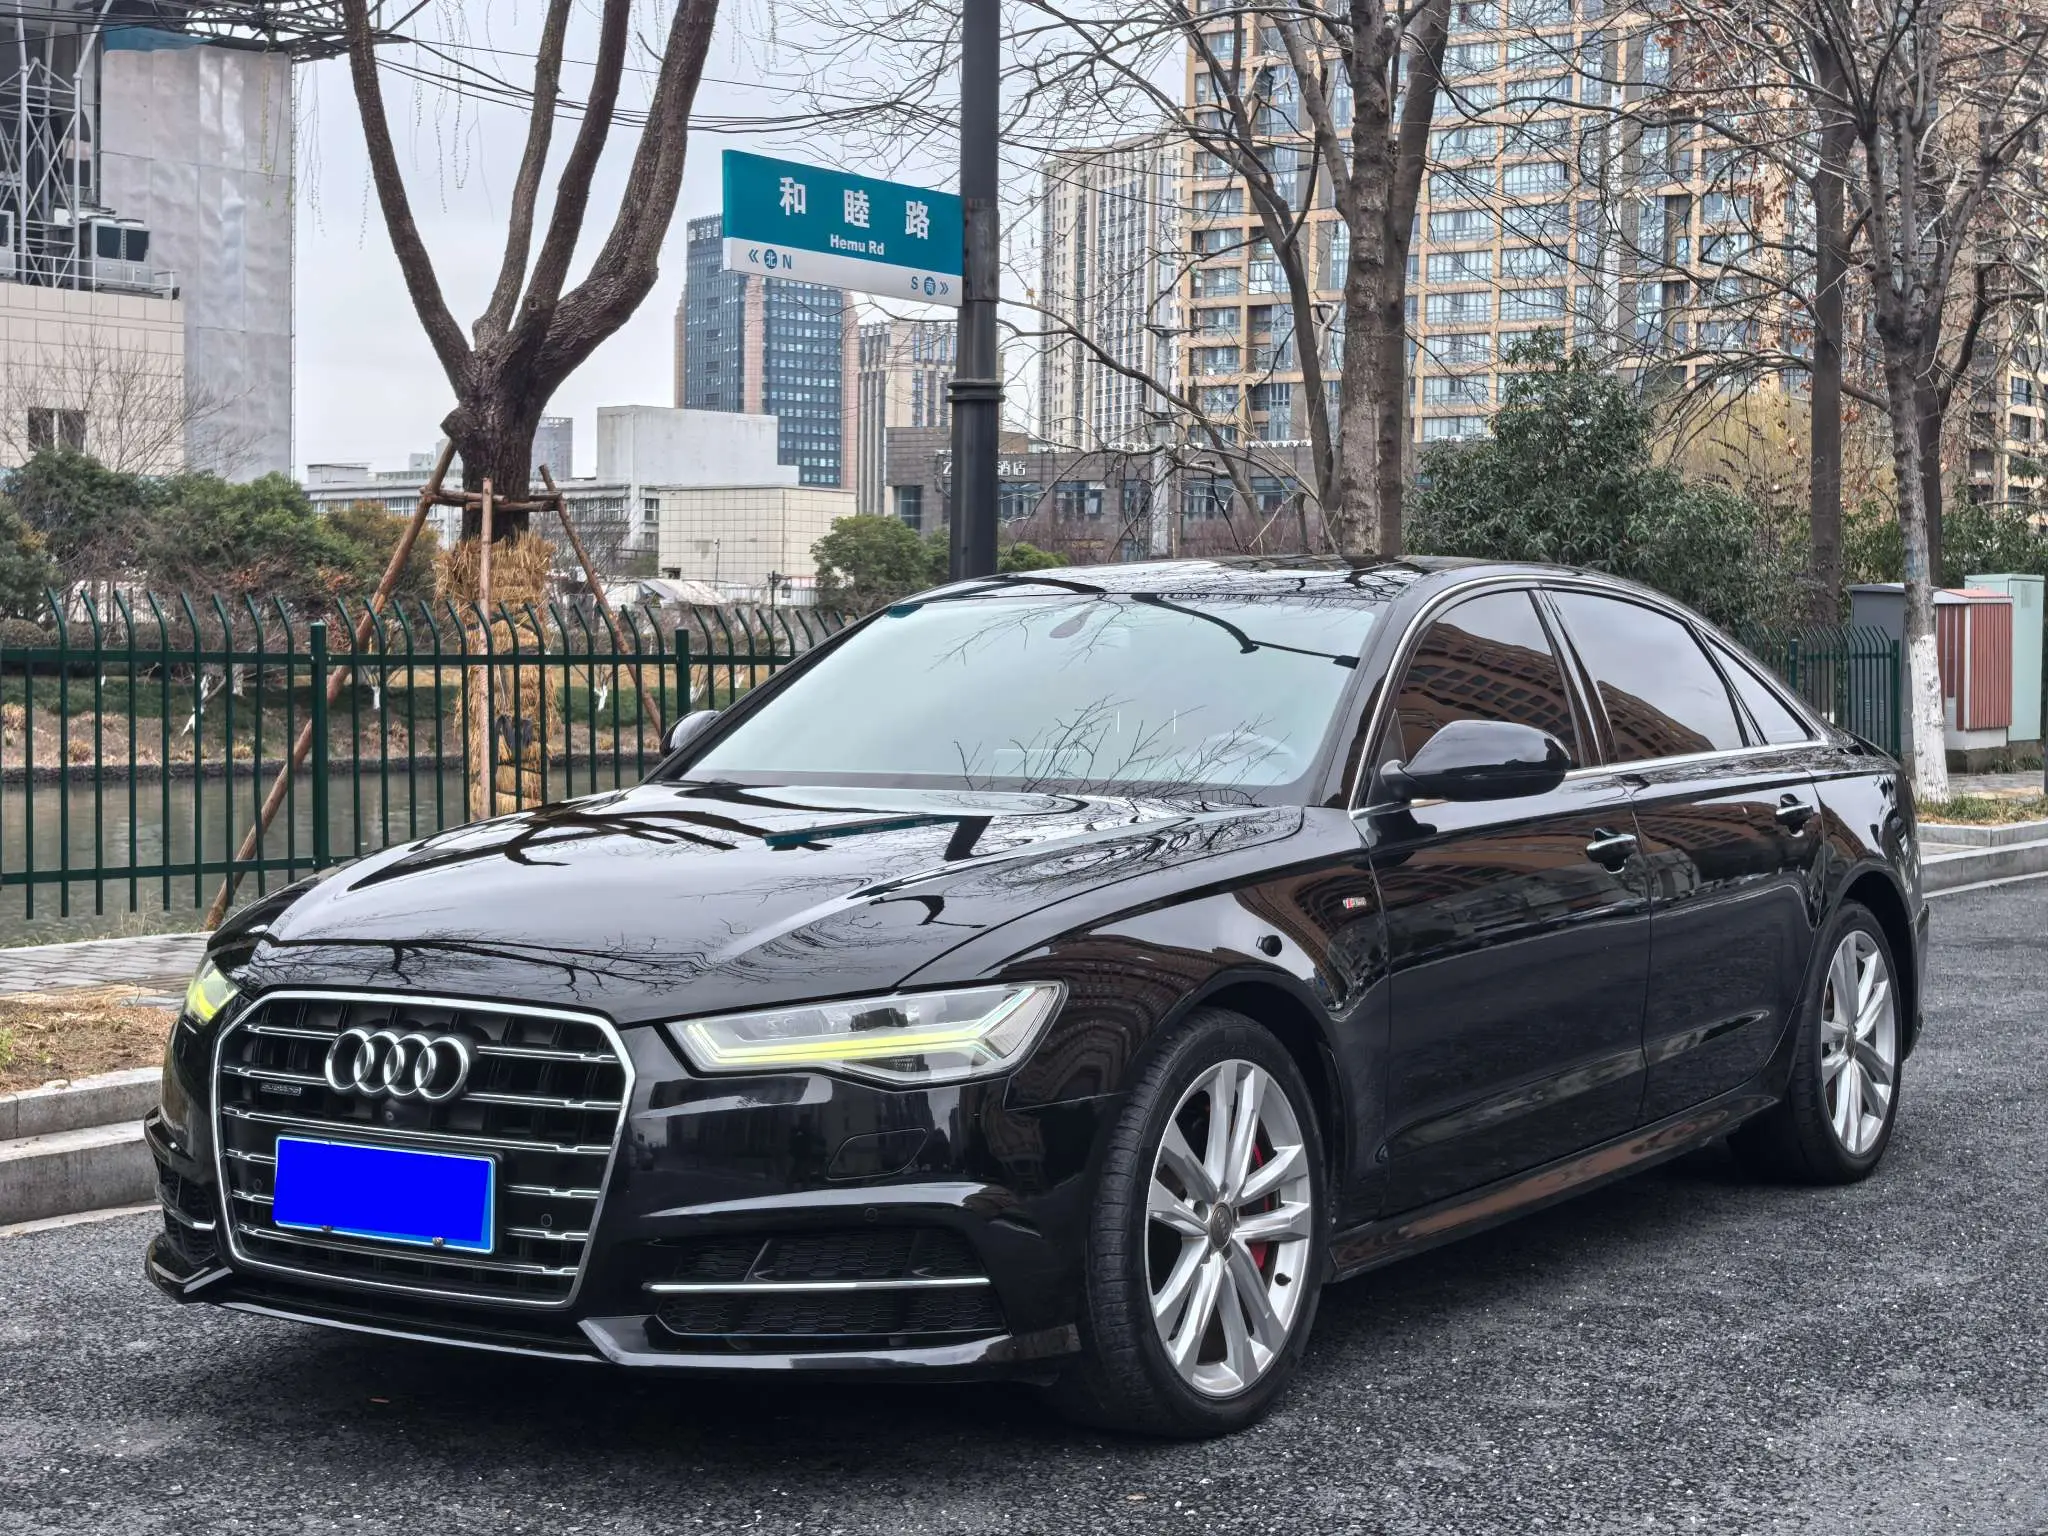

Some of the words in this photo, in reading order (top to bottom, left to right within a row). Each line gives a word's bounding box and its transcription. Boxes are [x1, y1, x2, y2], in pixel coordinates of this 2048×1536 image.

[779, 176, 930, 240] 和睦路
[830, 233, 866, 252] Hemu
[868, 240, 885, 256] Rd
[765, 250, 777, 268] 北
[782, 254, 792, 269] N
[911, 276, 919, 290] S
[924, 278, 935, 295] 南
